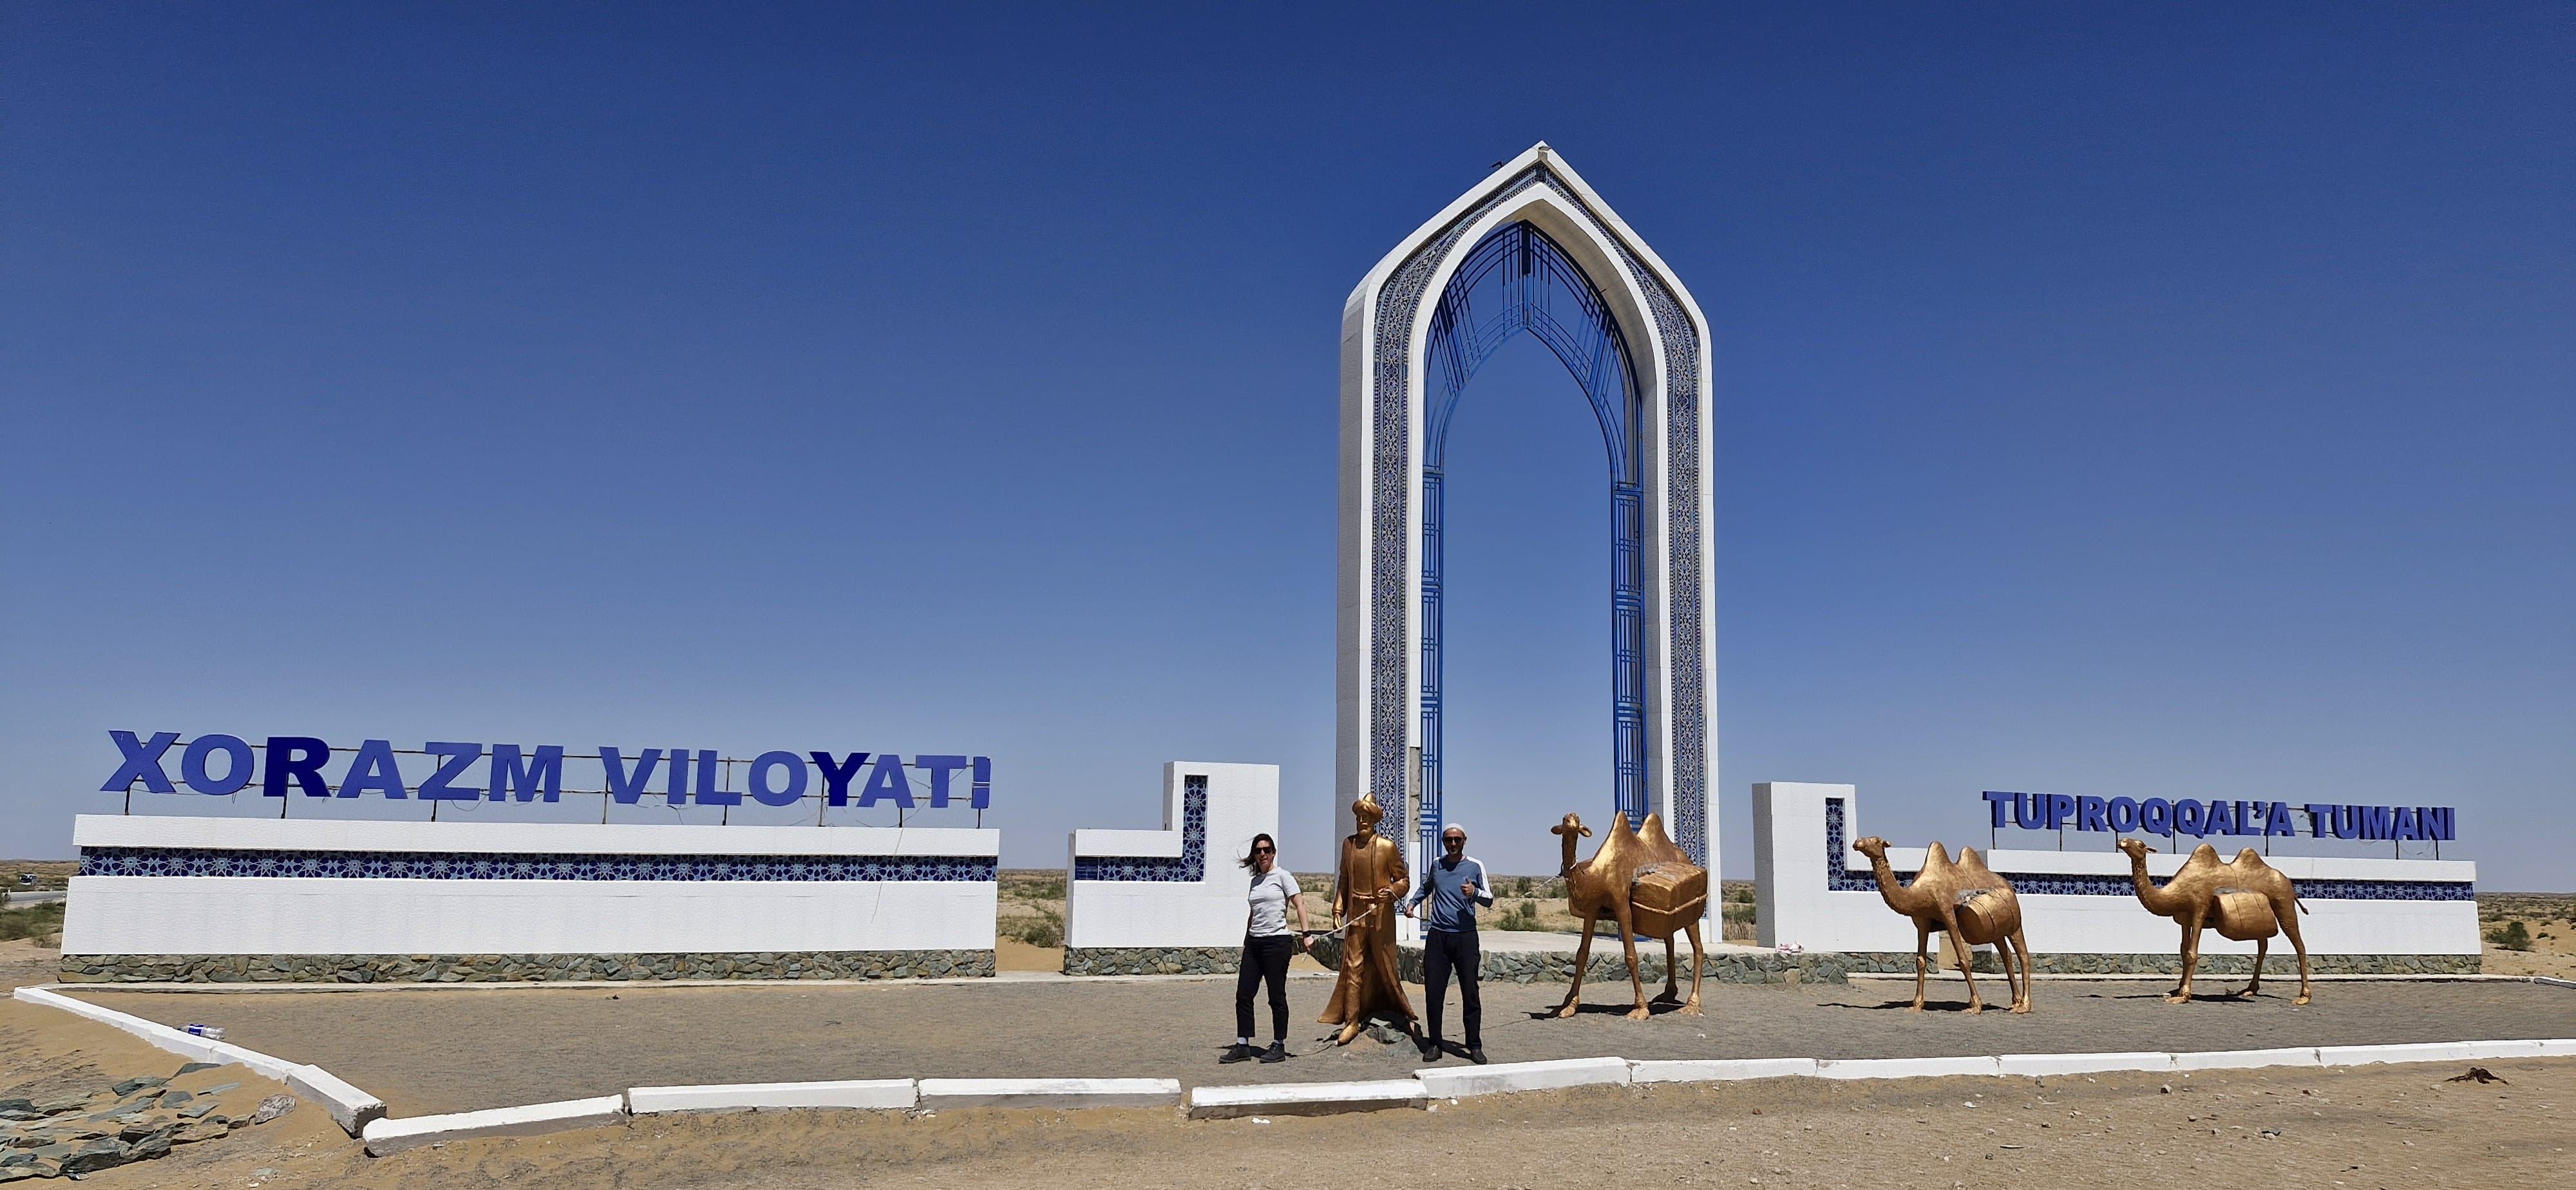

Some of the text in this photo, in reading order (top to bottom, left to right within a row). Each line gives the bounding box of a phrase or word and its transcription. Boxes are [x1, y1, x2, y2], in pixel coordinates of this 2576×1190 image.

[99, 730, 991, 809] XORAZM VILOYATI
[2304, 803, 2456, 840] TUMANI
